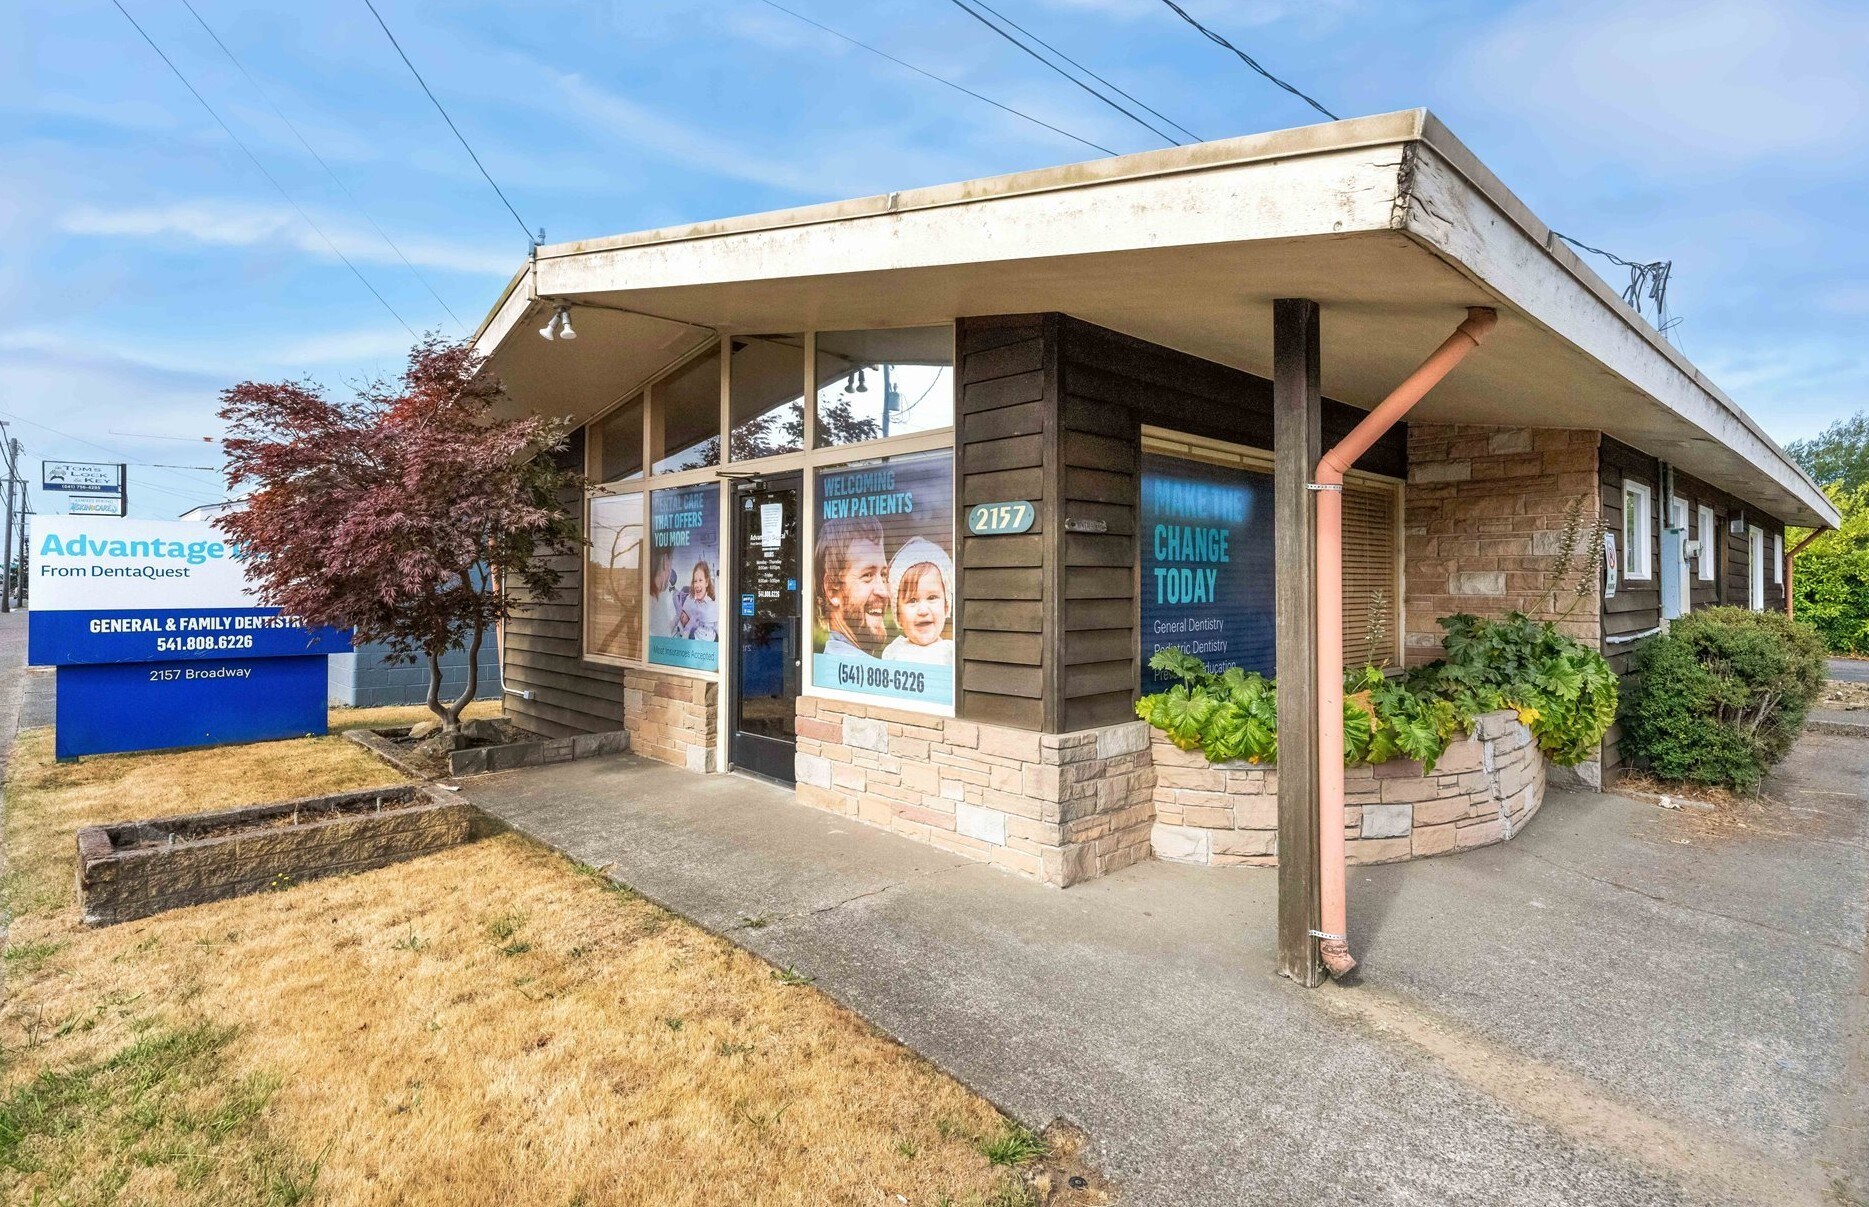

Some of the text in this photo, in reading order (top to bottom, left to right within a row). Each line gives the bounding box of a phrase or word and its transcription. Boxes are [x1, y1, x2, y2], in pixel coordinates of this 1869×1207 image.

[823, 470, 896, 498] WELCOMING
[683, 492, 704, 510] CARE
[823, 491, 913, 520] NEW PATIENTS
[654, 511, 703, 530] THAT OFFERS
[975, 505, 1026, 530] 2157
[654, 530, 691, 548] YOU MORE
[1154, 524, 1230, 563] CHANGE
[40, 533, 225, 565] Advantage
[41, 564, 191, 580] From DentaQuest
[1154, 567, 1218, 605] TODAY
[89, 617, 162, 634] GENERAL
[165, 616, 177, 632] &
[179, 615, 233, 631] FAMILY
[1153, 617, 1224, 634] General Dentistry
[157, 634, 253, 651] 541.808.6226
[1192, 639, 1228, 654] Dentistry
[149, 667, 252, 681] 2157 Broadway
[838, 662, 925, 693] (541) 808-6226
